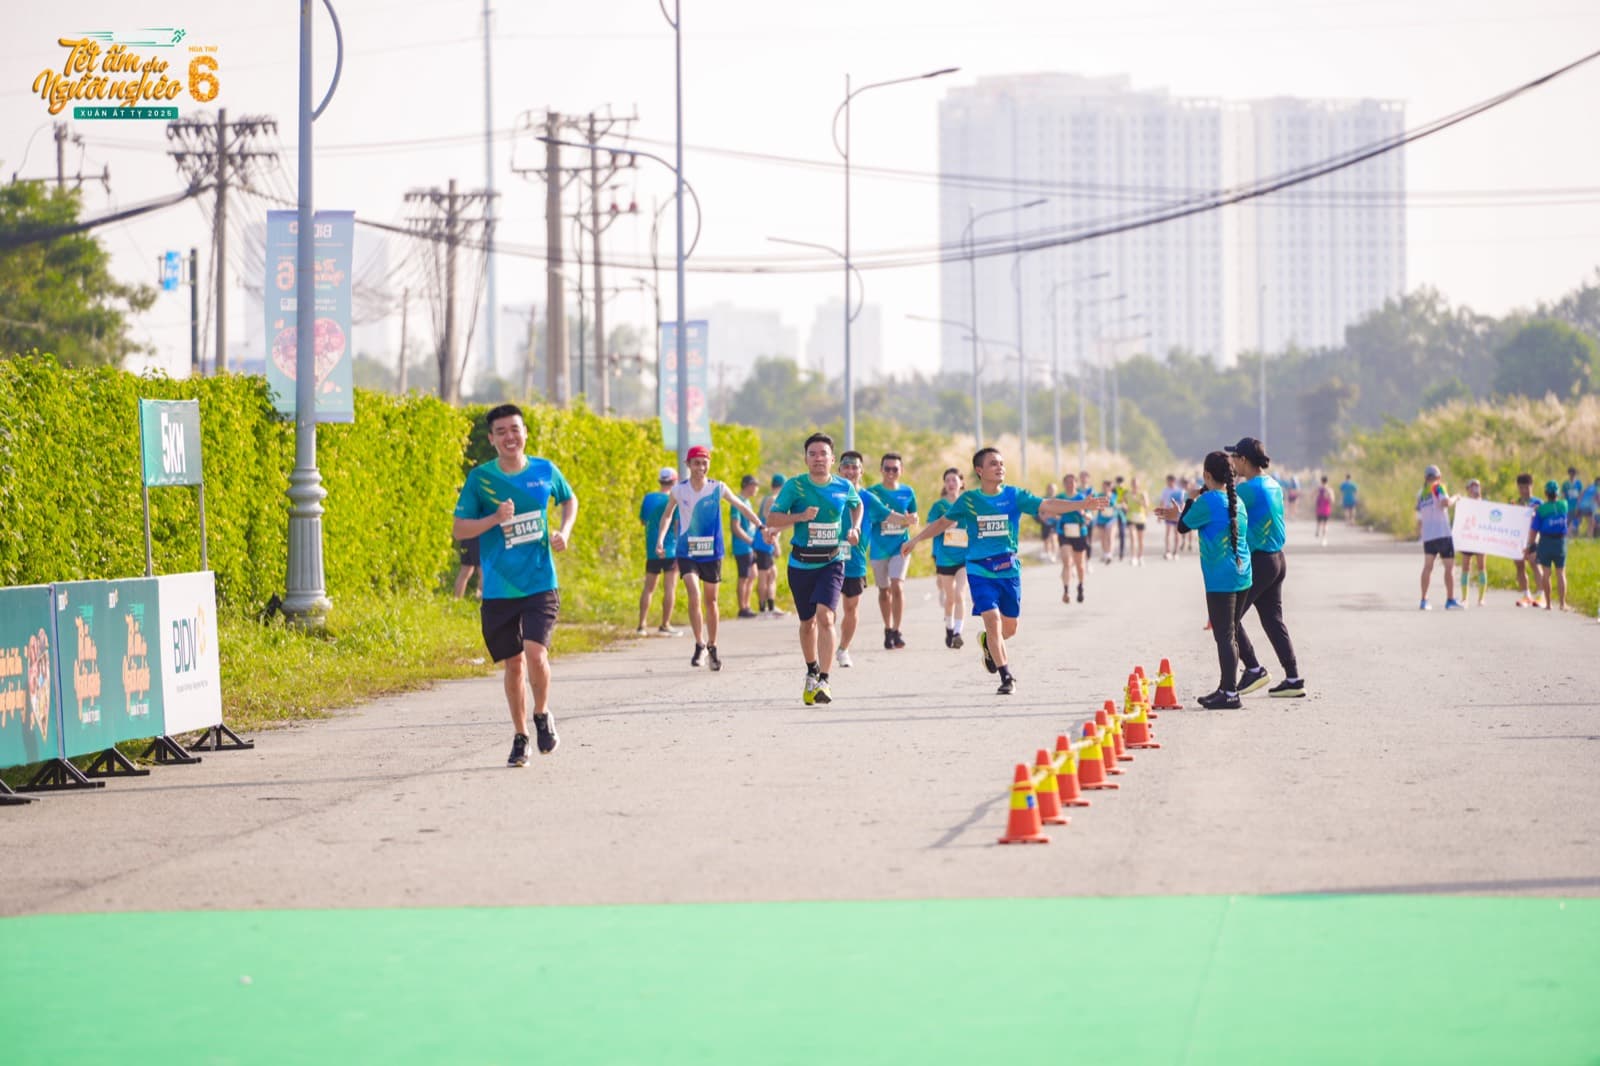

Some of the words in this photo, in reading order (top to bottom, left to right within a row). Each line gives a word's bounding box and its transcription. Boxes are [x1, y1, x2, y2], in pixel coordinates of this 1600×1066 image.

[514, 519, 538, 536] 8144
[986, 521, 1005, 530] 8734
[172, 617, 197, 674] BIDV
